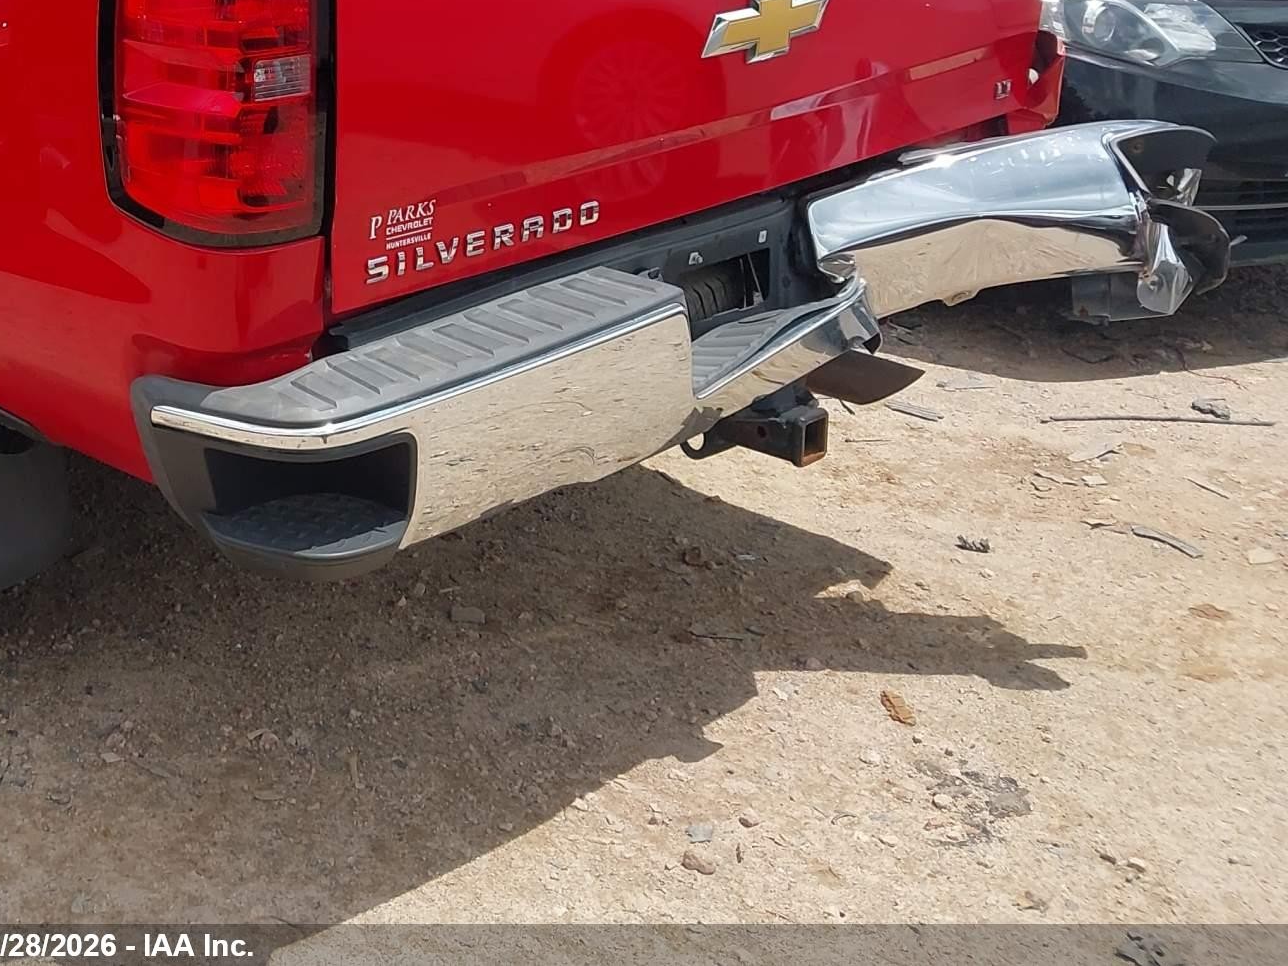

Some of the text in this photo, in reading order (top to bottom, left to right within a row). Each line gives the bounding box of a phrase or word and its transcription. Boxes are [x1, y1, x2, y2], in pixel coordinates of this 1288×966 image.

[386, 199, 436, 225] PARKS
[385, 217, 433, 236] CHEVROLET
[366, 200, 600, 284] SILVERADO
[385, 232, 432, 251] HUNTERSVILLE
